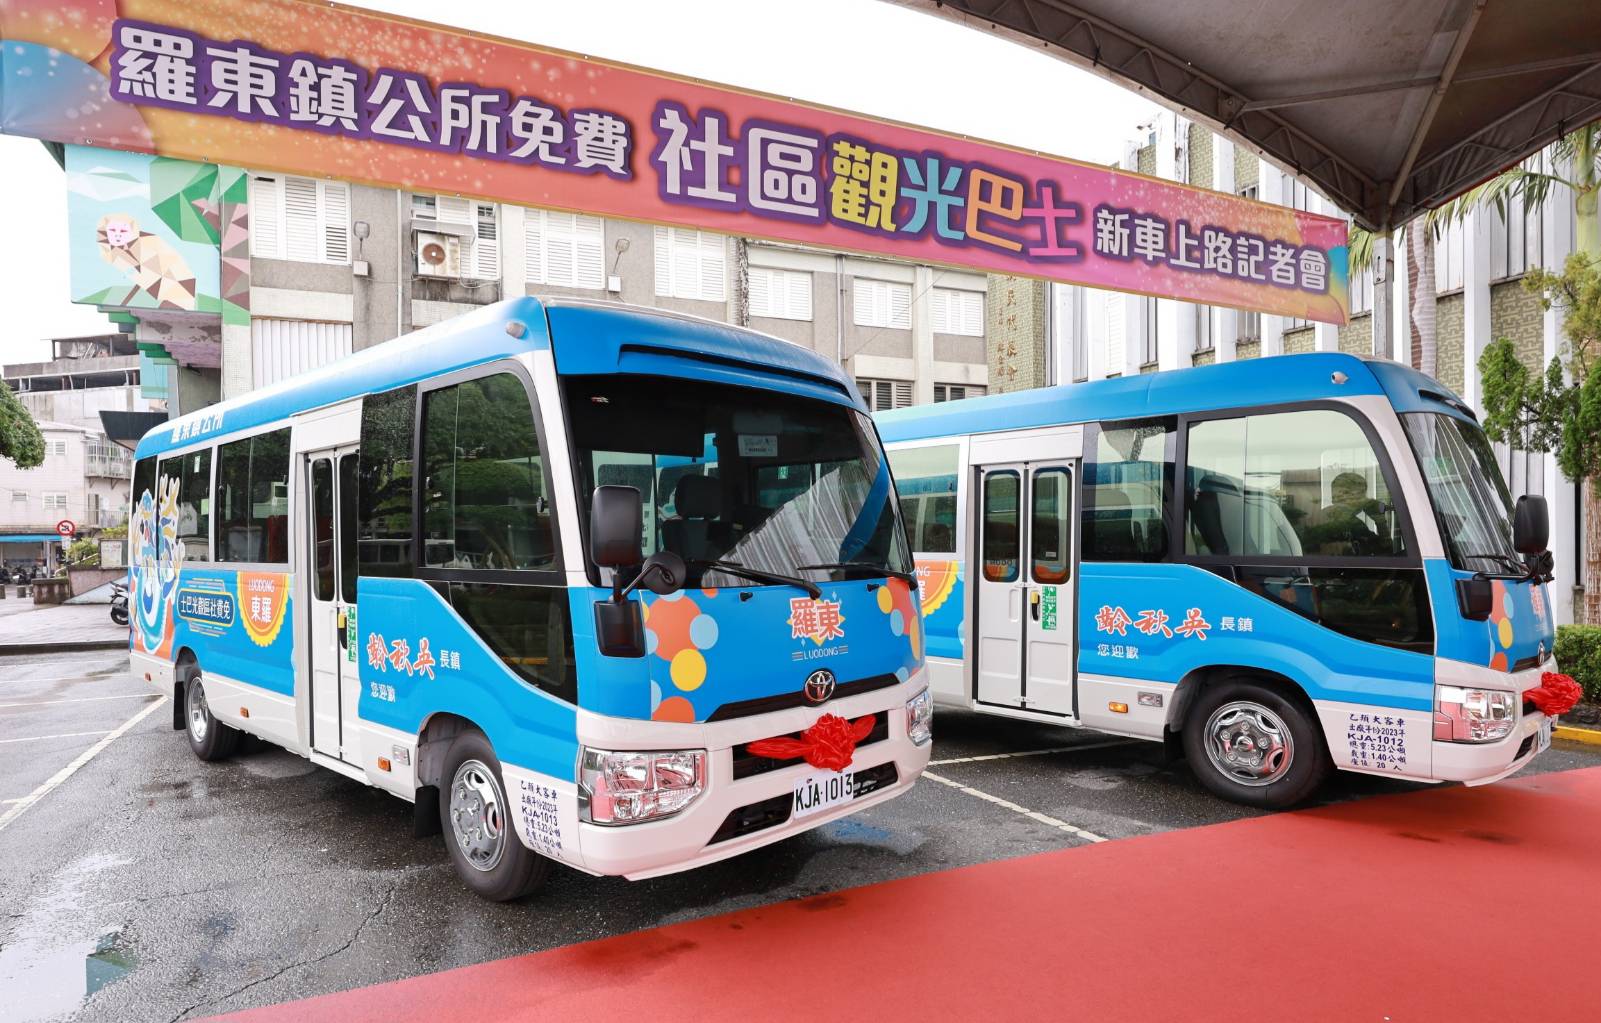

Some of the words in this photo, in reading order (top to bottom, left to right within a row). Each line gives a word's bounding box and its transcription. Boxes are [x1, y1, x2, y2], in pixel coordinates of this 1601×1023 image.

[117, 26, 630, 176] 羅東鎮公所免費
[659, 108, 1077, 256] 社區觀光巴士
[1096, 208, 1327, 291] 新車上路記者會
[789, 597, 845, 640] 羅東
[803, 646, 839, 660] LUODONG
[1347, 733, 1404, 747] KJA-1012
